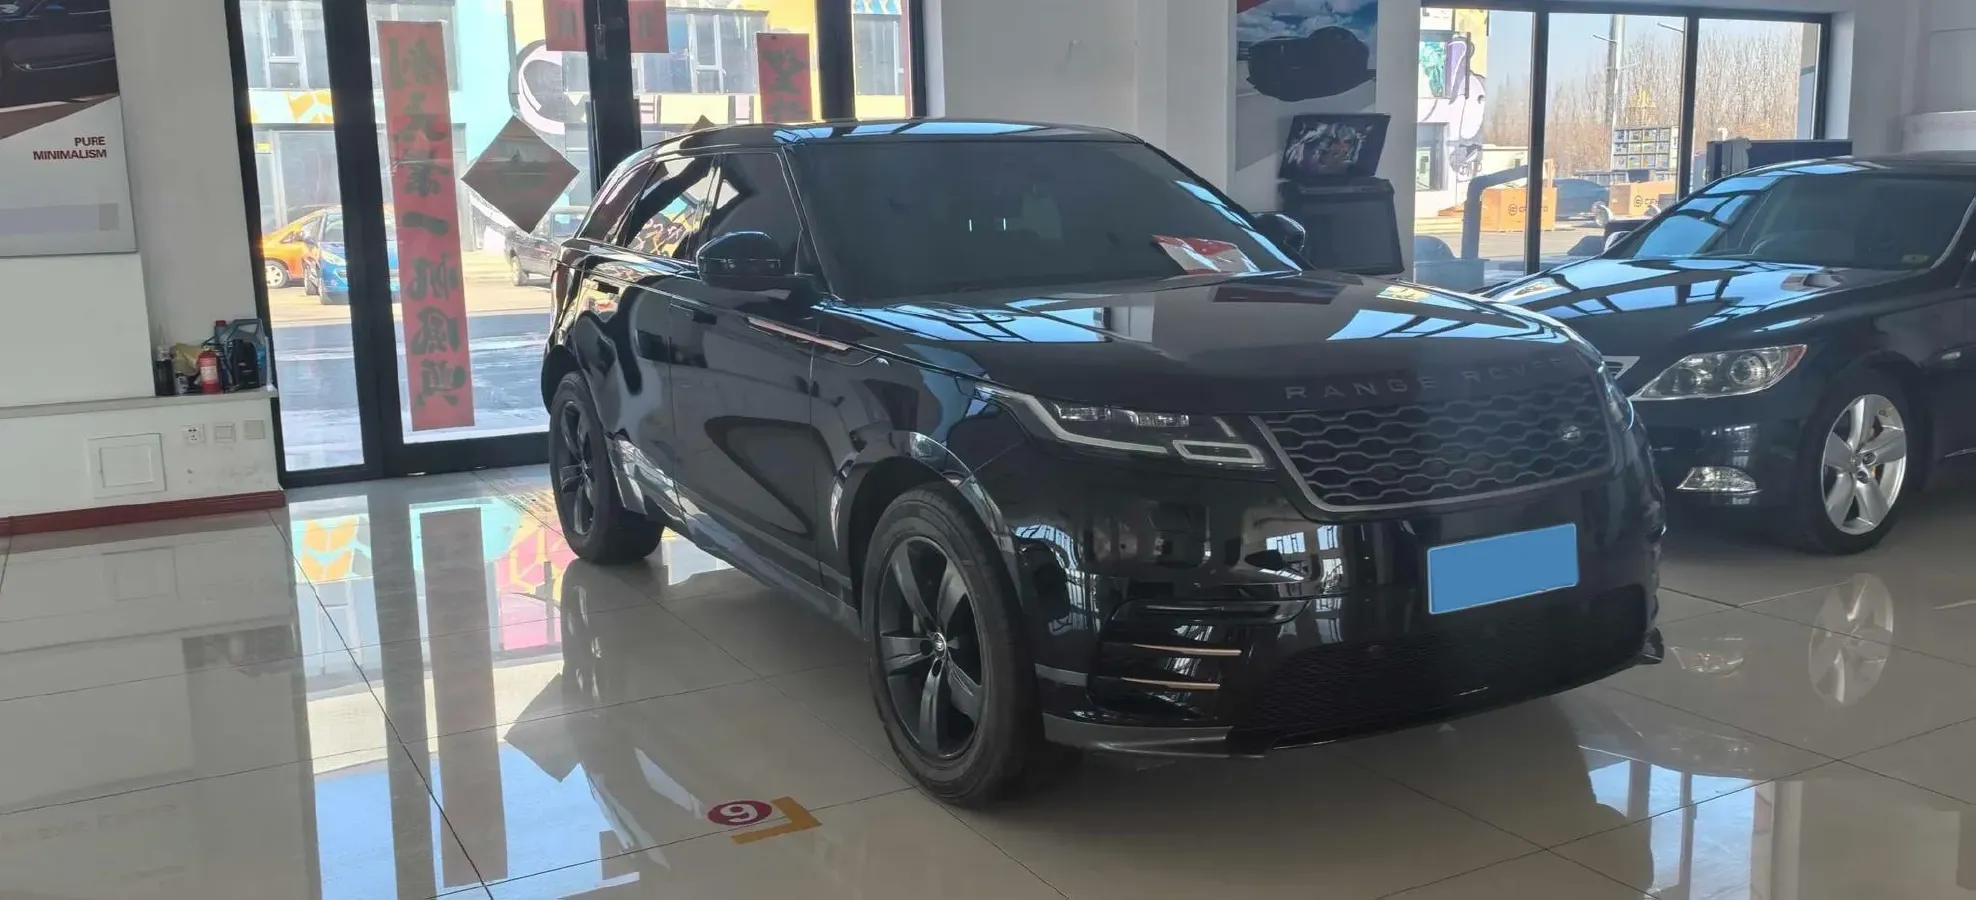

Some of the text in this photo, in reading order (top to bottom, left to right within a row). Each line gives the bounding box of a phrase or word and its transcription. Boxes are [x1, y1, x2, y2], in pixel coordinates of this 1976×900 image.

[74, 136, 106, 147] PURE
[32, 149, 107, 161] MINIMALISM
[1284, 376, 1438, 399] RANGE
